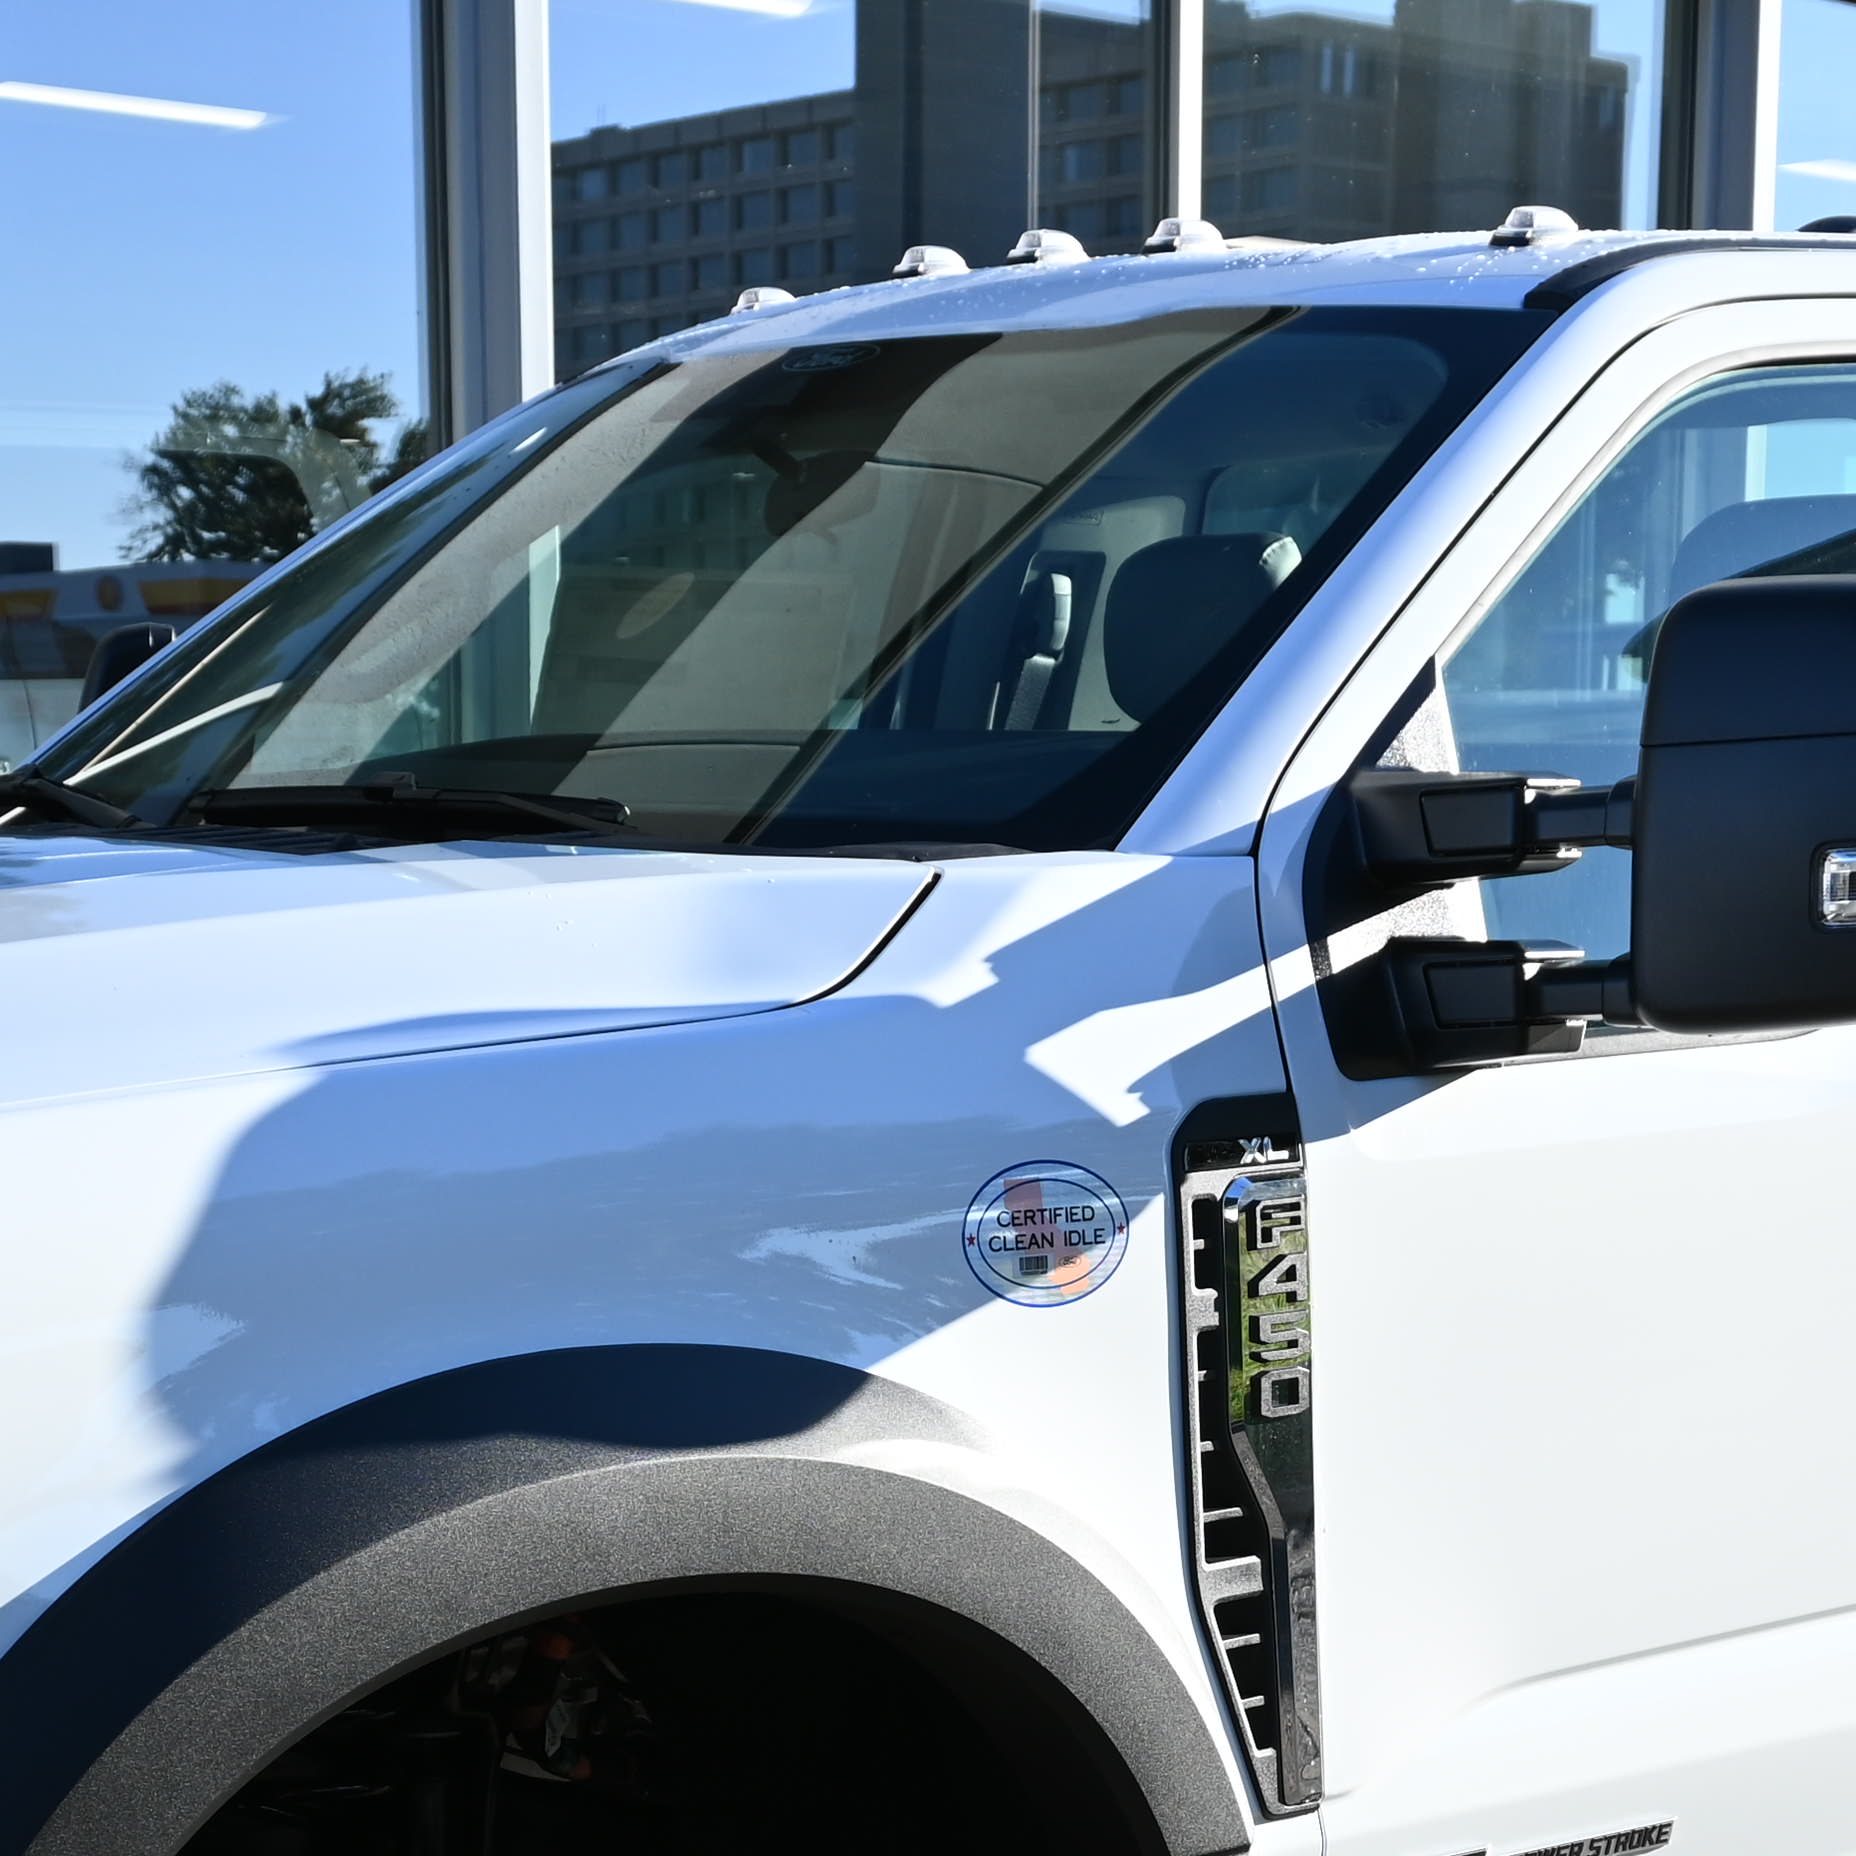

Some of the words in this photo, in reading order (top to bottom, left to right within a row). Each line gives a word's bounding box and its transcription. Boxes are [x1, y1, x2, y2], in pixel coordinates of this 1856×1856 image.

[1240, 1137, 1289, 1164] XL
[997, 1205, 1095, 1228] CERTIFIED
[988, 1232, 1054, 1252] CLEAN
[1064, 1228, 1106, 1247] IDLE
[1248, 1196, 1311, 1419] F450
